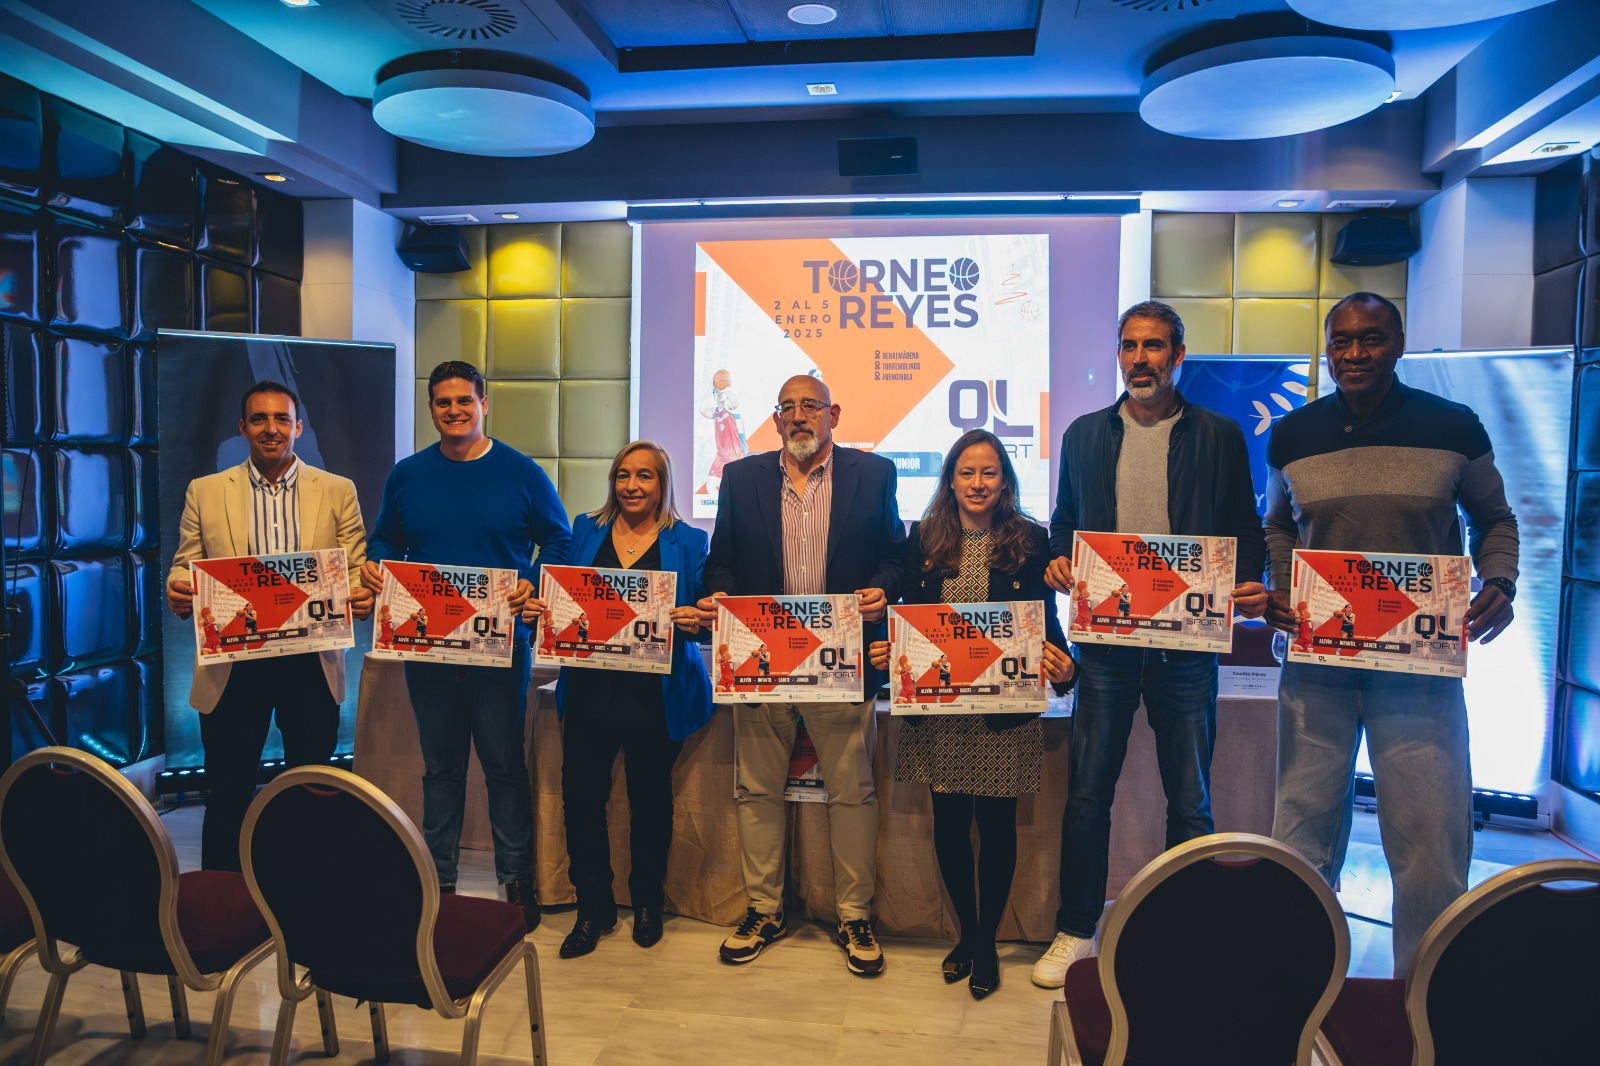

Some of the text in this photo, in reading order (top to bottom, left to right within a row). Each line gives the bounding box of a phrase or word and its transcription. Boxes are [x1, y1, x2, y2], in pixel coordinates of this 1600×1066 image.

[803, 257, 980, 294] TORNEO
[774, 300, 829, 310] 2 AL 5
[840, 294, 979, 328] REYES
[776, 315, 831, 324] ENERO
[784, 329, 822, 338] 2025
[883, 373, 912, 381] FUENGIROLA
[1122, 541, 1202, 557] TORNEO
[239, 557, 317, 575] TORNEO
[1138, 556, 1201, 572] REYES
[1344, 559, 1433, 577] TORNEO
[257, 570, 318, 587] REYES
[419, 570, 489, 586] TORNEO
[581, 574, 648, 589] TORNEO
[1361, 576, 1432, 592] REYES
[432, 584, 487, 599] REYES
[594, 587, 647, 602] REYES
[308, 599, 344, 621] QL
[758, 601, 832, 615] TORNEO
[1186, 593, 1224, 618] QL
[311, 620, 345, 629] SPORT
[474, 616, 506, 637] QL
[774, 616, 832, 629] REYES
[937, 611, 1013, 626] TORNEO
[1187, 618, 1224, 627] SPORT
[634, 621, 666, 642] QL
[954, 625, 1013, 639] REYES
[1415, 614, 1459, 641] QL
[1416, 641, 1458, 650] SPORT
[820, 648, 855, 670] QL
[1002, 657, 1038, 679] QL
